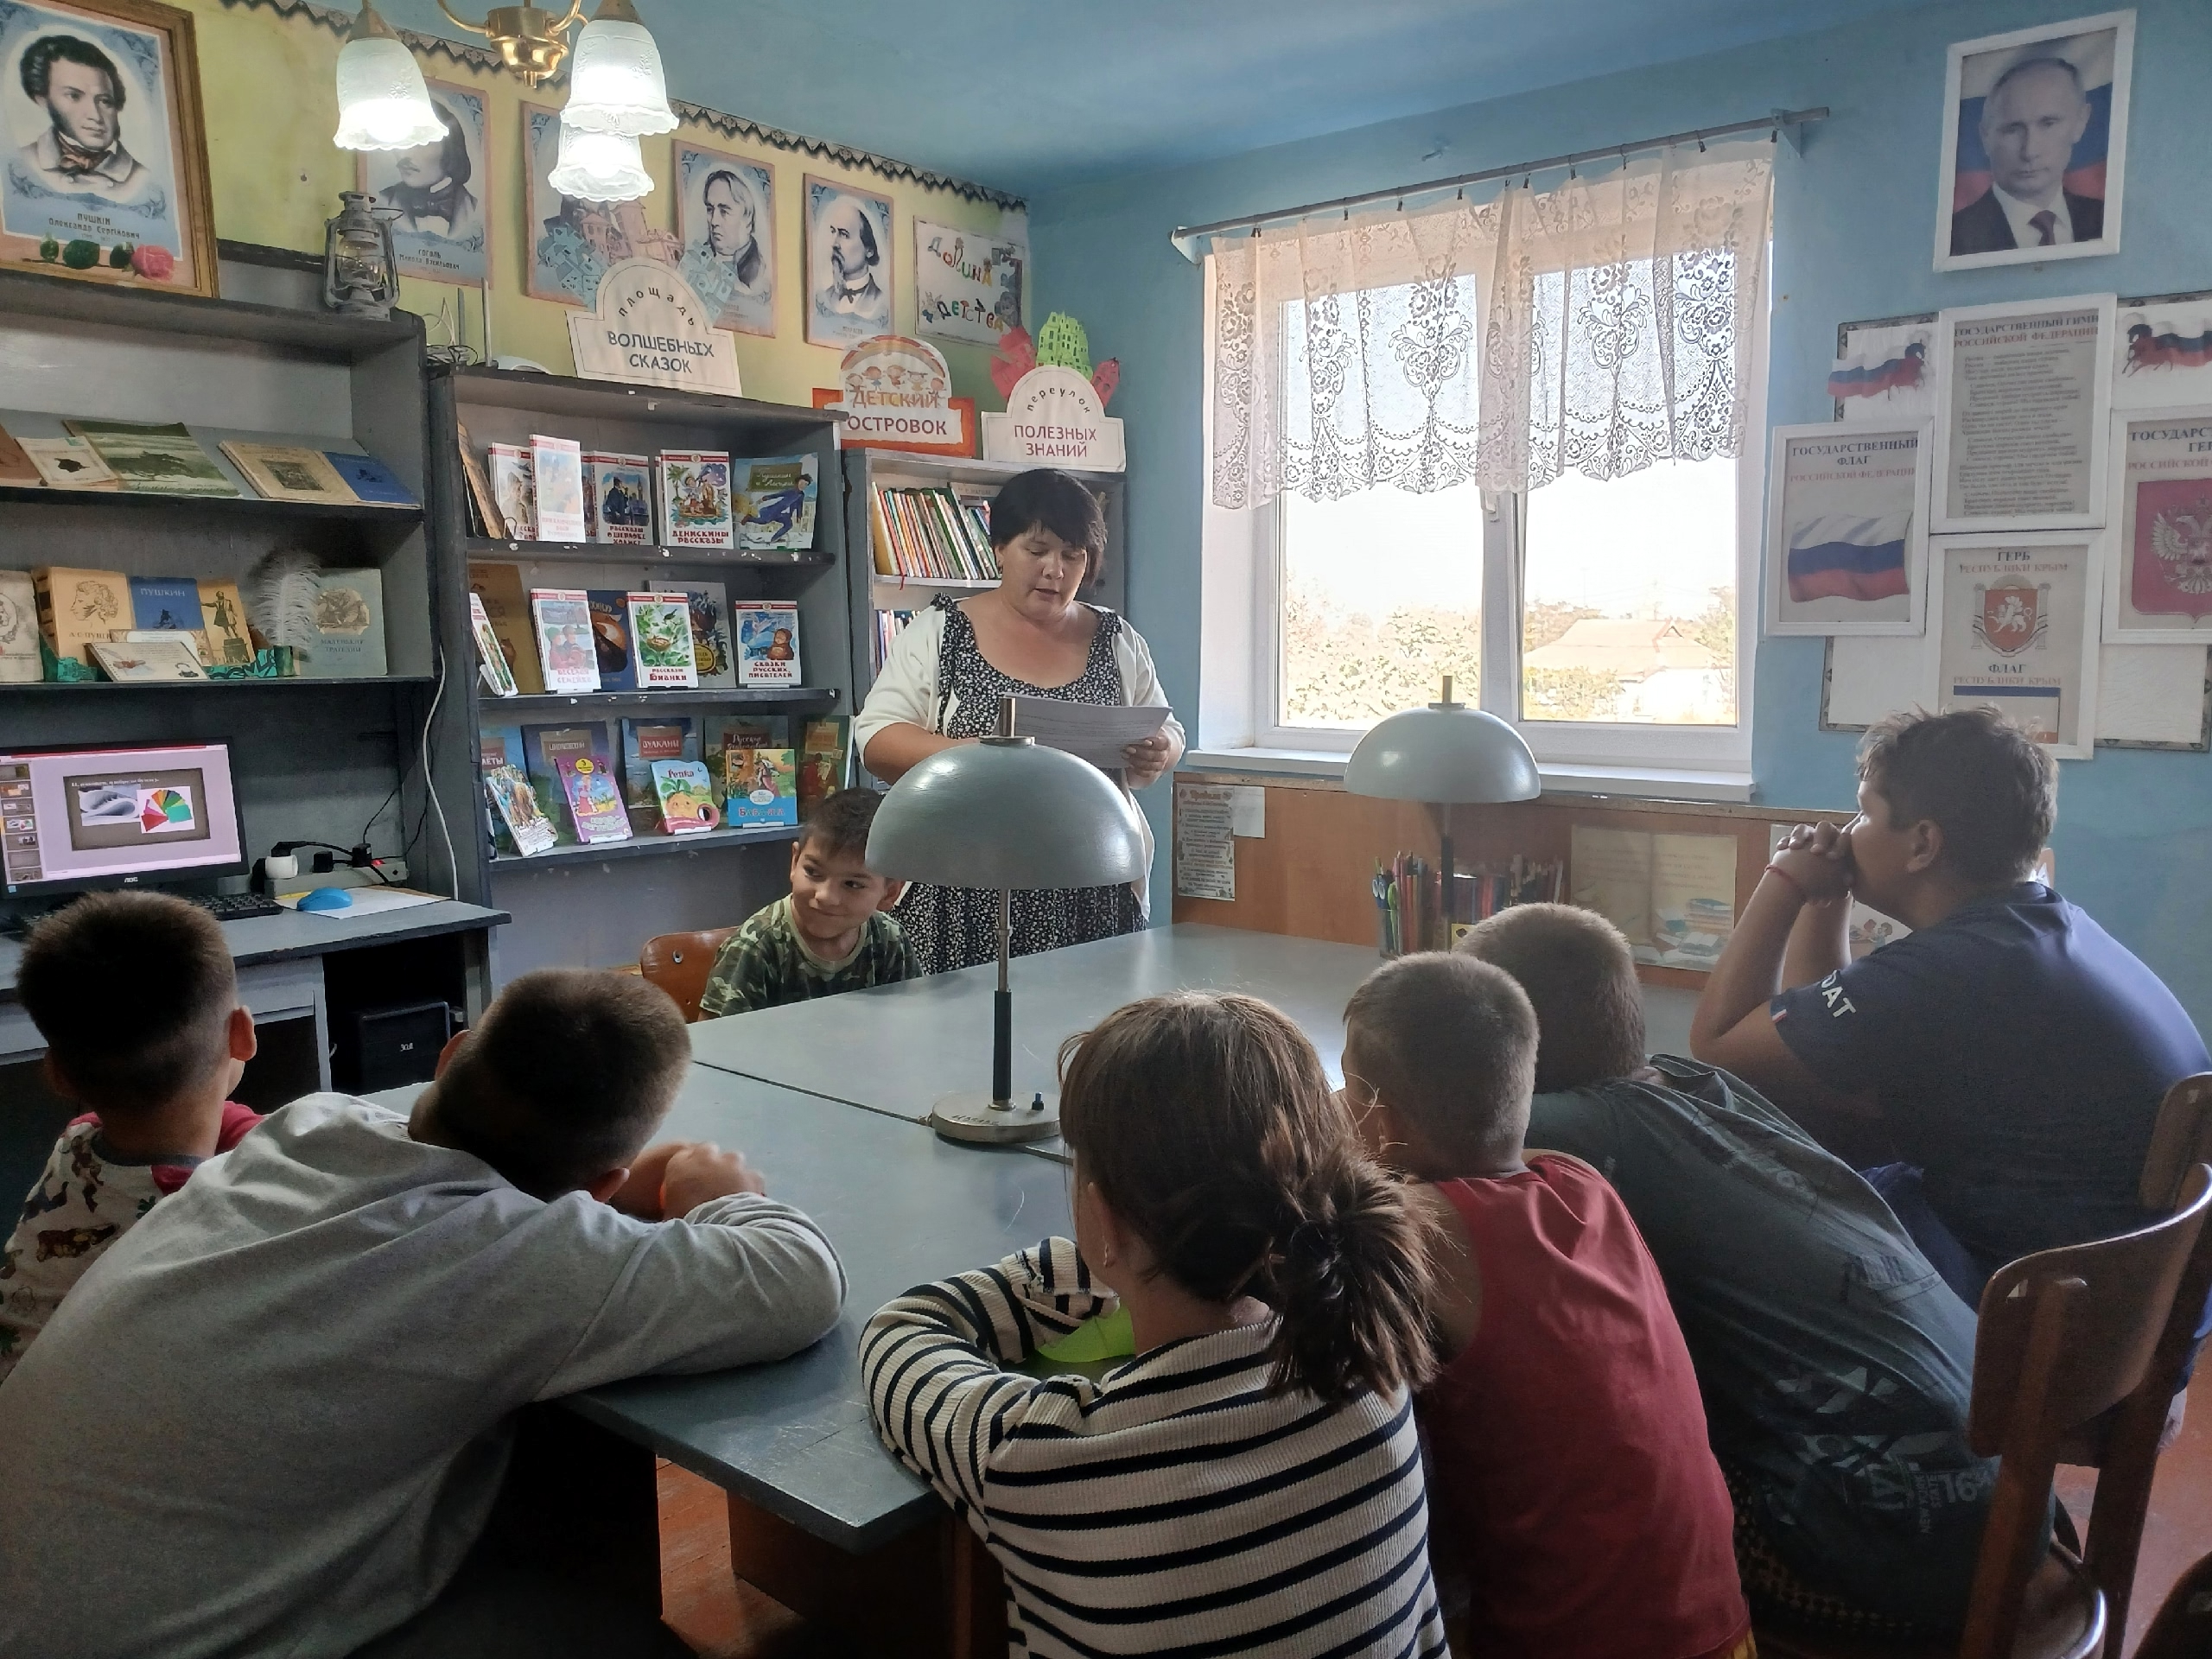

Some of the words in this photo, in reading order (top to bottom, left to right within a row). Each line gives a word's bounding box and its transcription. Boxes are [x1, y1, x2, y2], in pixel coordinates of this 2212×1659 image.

[77, 213, 111, 226] ПУШКІН
[607, 330, 715, 358] ВОЛШЕБНЫХ
[629, 353, 692, 373] СКАЗОК
[852, 390, 939, 409] ДЕТСКИЙ
[1027, 387, 1090, 413] переулок
[847, 416, 947, 435] ОСТРОВОК
[1014, 425, 1096, 441] ПОЛЕЗНЫХ
[1026, 442, 1087, 457] ЗНАНИЙ
[1793, 436, 1918, 456] ГОСУДАРСТВЕННЫЙ
[1837, 455, 1872, 466] ФЛАГ
[1997, 551, 2031, 562] ГЕРБ
[140, 588, 185, 597] ПУШКИН
[1988, 664, 2026, 674] ФЛАГ
